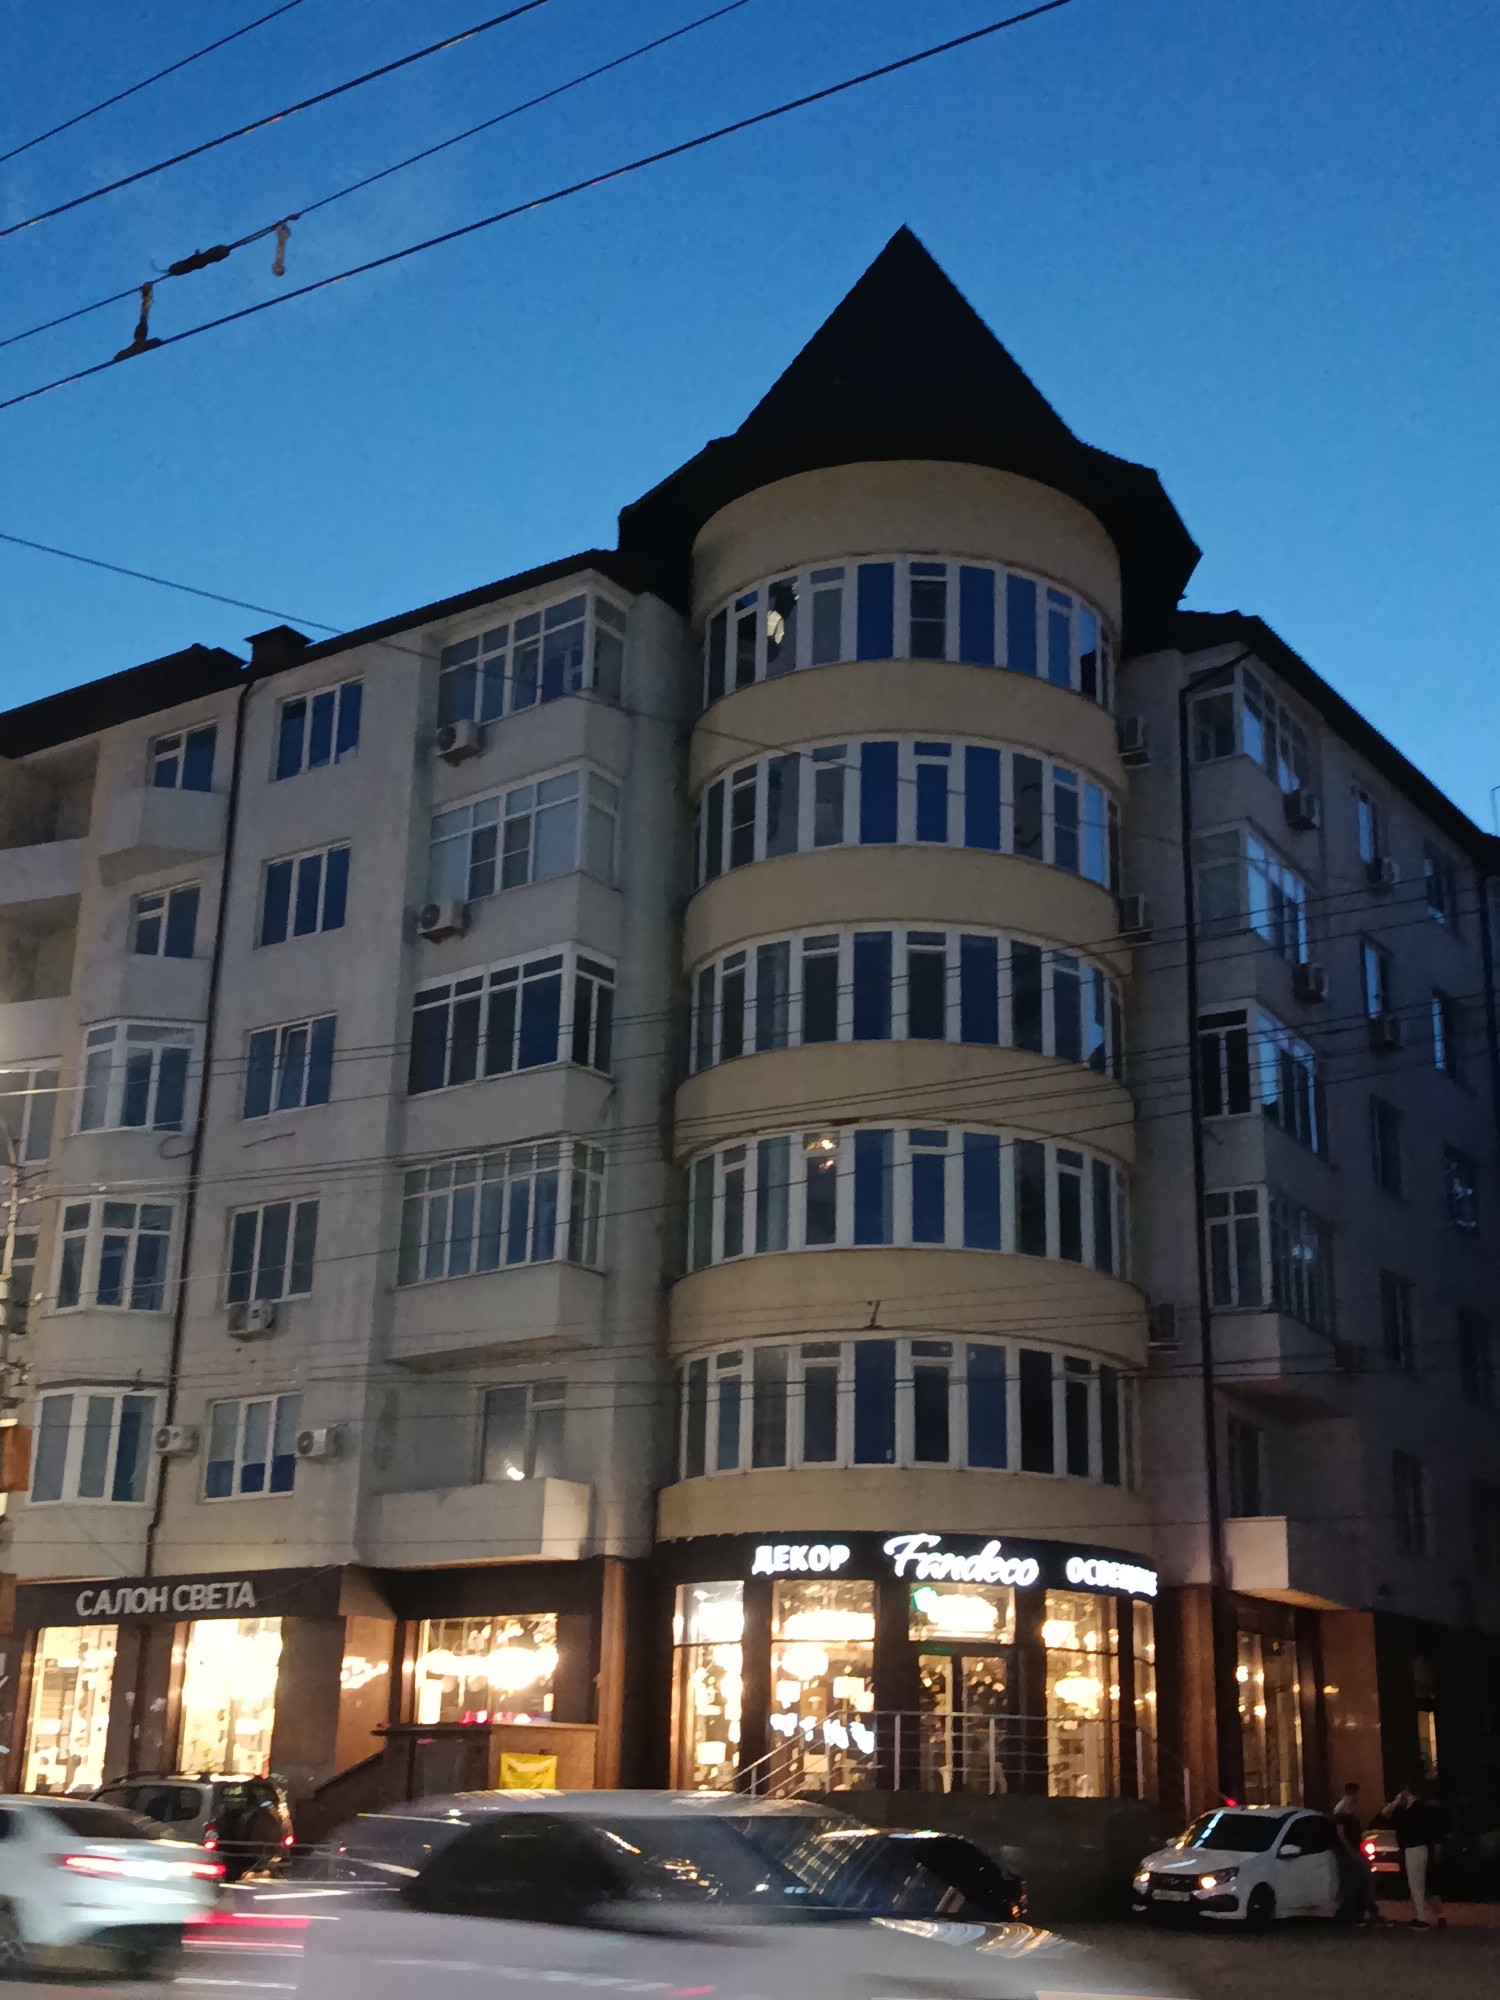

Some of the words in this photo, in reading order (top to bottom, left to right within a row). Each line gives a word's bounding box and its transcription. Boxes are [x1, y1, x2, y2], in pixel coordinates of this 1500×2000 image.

[751, 1544, 850, 1575] ДЕКОР
[883, 1533, 1039, 1586] Fandeco
[76, 1586, 169, 1616] САЛОН
[172, 1581, 256, 1612] СВЕТА
